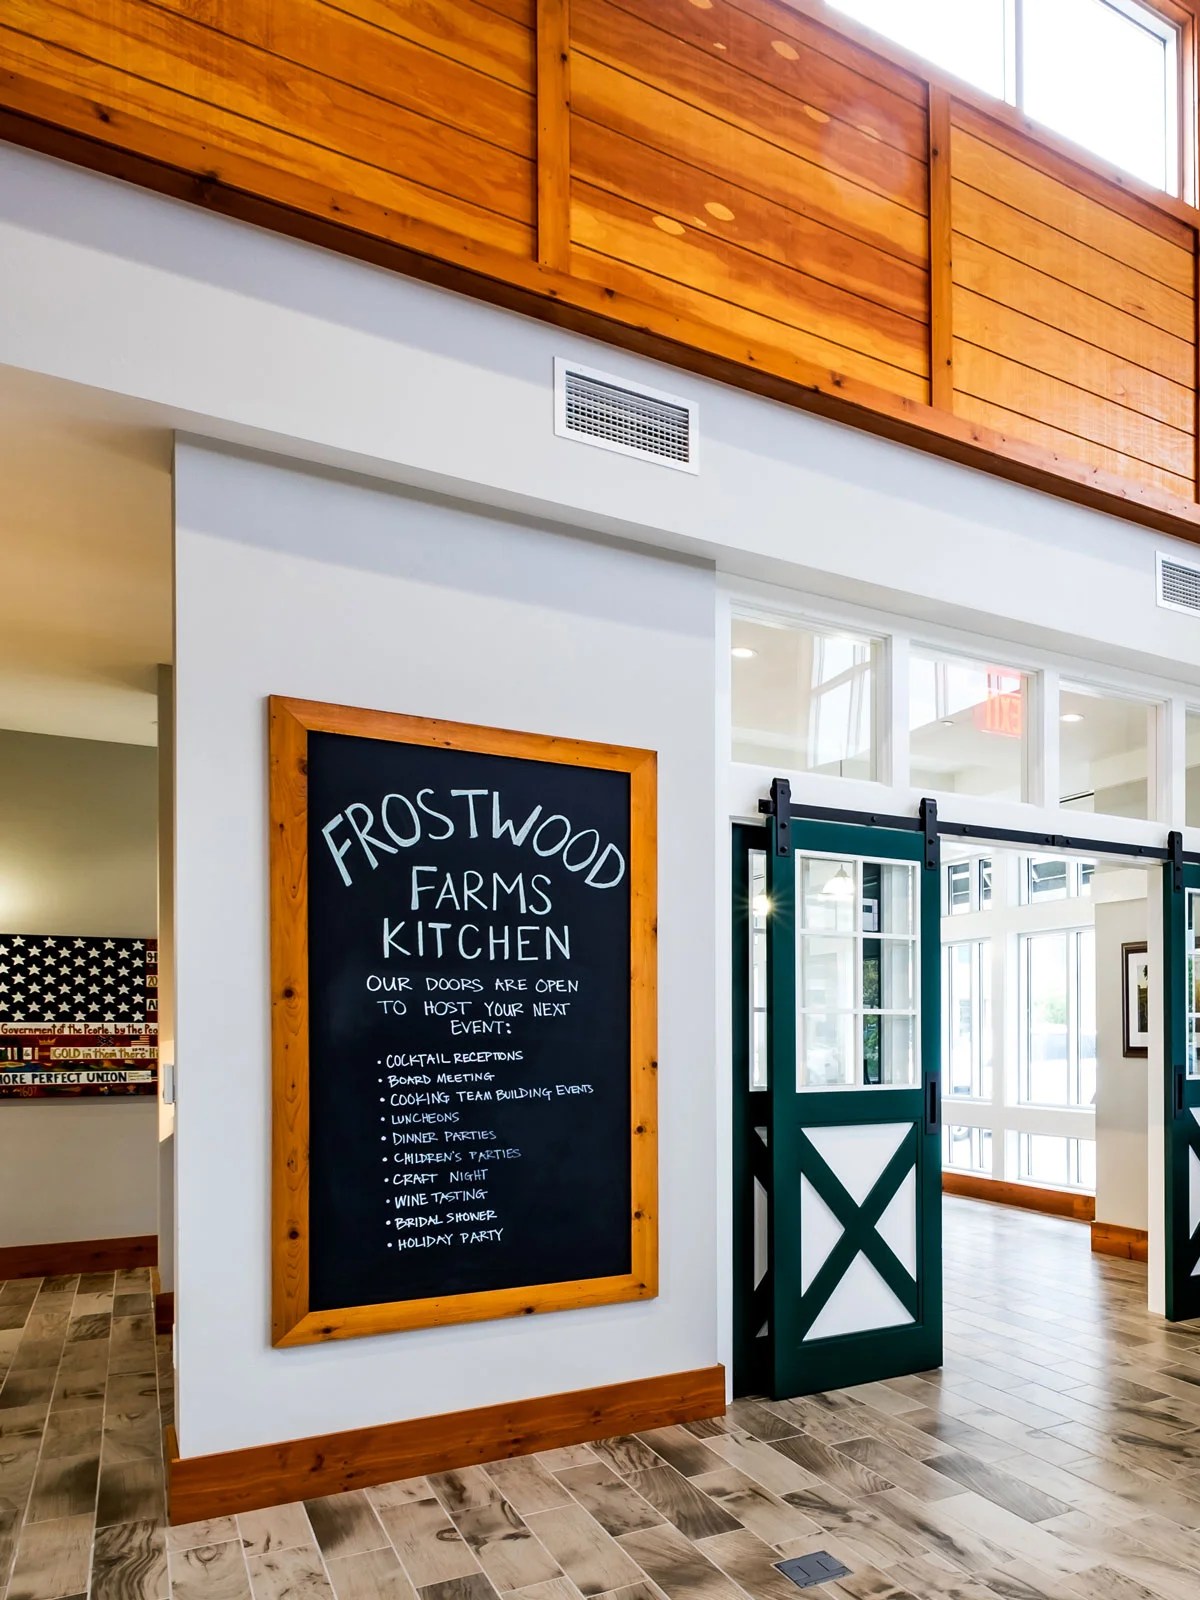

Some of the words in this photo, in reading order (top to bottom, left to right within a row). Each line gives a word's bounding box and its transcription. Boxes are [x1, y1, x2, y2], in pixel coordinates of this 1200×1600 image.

[322, 789, 625, 890] FROSTWOOD
[411, 866, 551, 915] FARMS
[383, 918, 570, 960] KITCHEN
[367, 975, 412, 991] OUR
[426, 978, 483, 992] DOORS
[495, 979, 527, 991] ARE
[536, 979, 578, 992] OPEN
[377, 1000, 406, 1015] TO
[424, 1001, 472, 1015] HOST
[484, 1001, 523, 1016] YOUR
[533, 1002, 570, 1017] NEXT
[1, 1024, 56, 1034] Government
[68, 1024, 83, 1034] the
[115, 1024, 125, 1035] by
[127, 1024, 142, 1034] the
[451, 1020, 511, 1035] EVENT:
[53, 1047, 81, 1058] GOLD
[83, 1048, 92, 1058] in
[387, 1053, 451, 1068] COCKTAIL
[454, 1051, 523, 1063] RECEPTIONS
[31, 1073, 82, 1084] PERFECT
[86, 1072, 127, 1083] UNION
[388, 1075, 431, 1088] BOARD
[437, 1072, 495, 1083] MEETING
[391, 1091, 449, 1106] COOKING
[456, 1091, 492, 1102] TEAM
[496, 1088, 552, 1101] BUILDING
[556, 1085, 593, 1095] EVENTS
[392, 1112, 459, 1124] LUNCHEONS
[393, 1132, 438, 1145] DINNER
[445, 1131, 496, 1141] PARTIES
[394, 1151, 461, 1164] CHILDREN'S
[469, 1149, 522, 1162] PARTIES
[393, 1174, 438, 1185] CRAFT
[450, 1169, 488, 1182] NIGHT
[395, 1194, 428, 1209] WINE
[431, 1189, 487, 1204] TASTING
[395, 1215, 443, 1230] BRIDAL
[446, 1210, 497, 1223] SHOWER
[398, 1234, 453, 1250] HOLIDAY
[460, 1228, 503, 1243] PARTY
